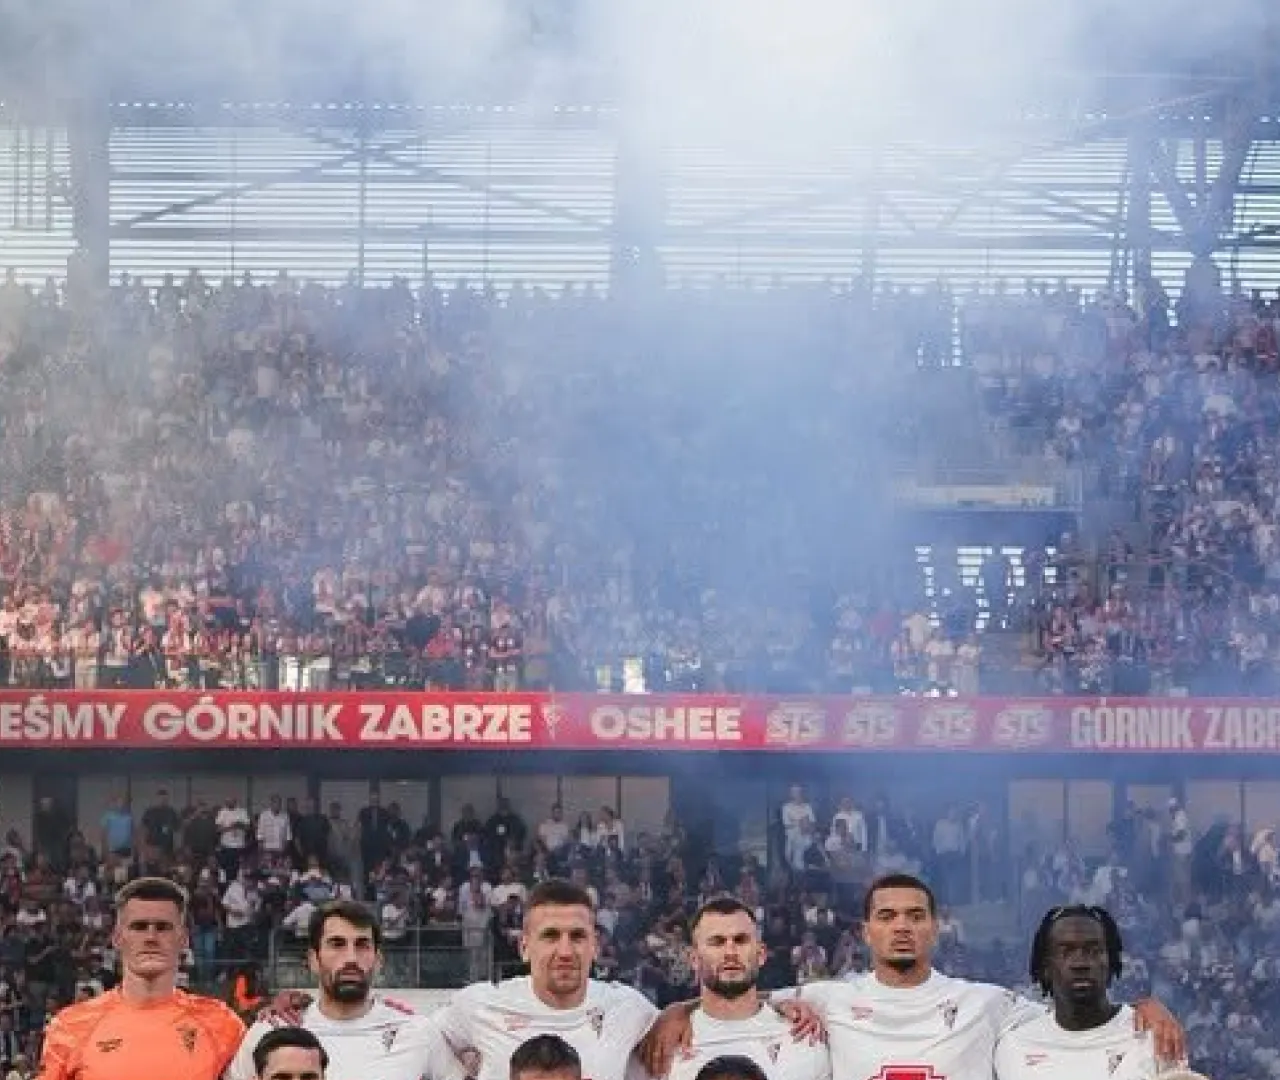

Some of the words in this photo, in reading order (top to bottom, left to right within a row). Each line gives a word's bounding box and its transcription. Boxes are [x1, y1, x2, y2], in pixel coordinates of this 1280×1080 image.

[143, 696, 344, 741] GÓRNIK
[358, 703, 532, 742] ZABRZE
[589, 705, 742, 741] OSHEE
[765, 702, 826, 746] STS
[842, 702, 898, 746] STS
[916, 702, 977, 747] STS
[992, 704, 1054, 749] STS
[1070, 697, 1195, 749] GÓRNIK
